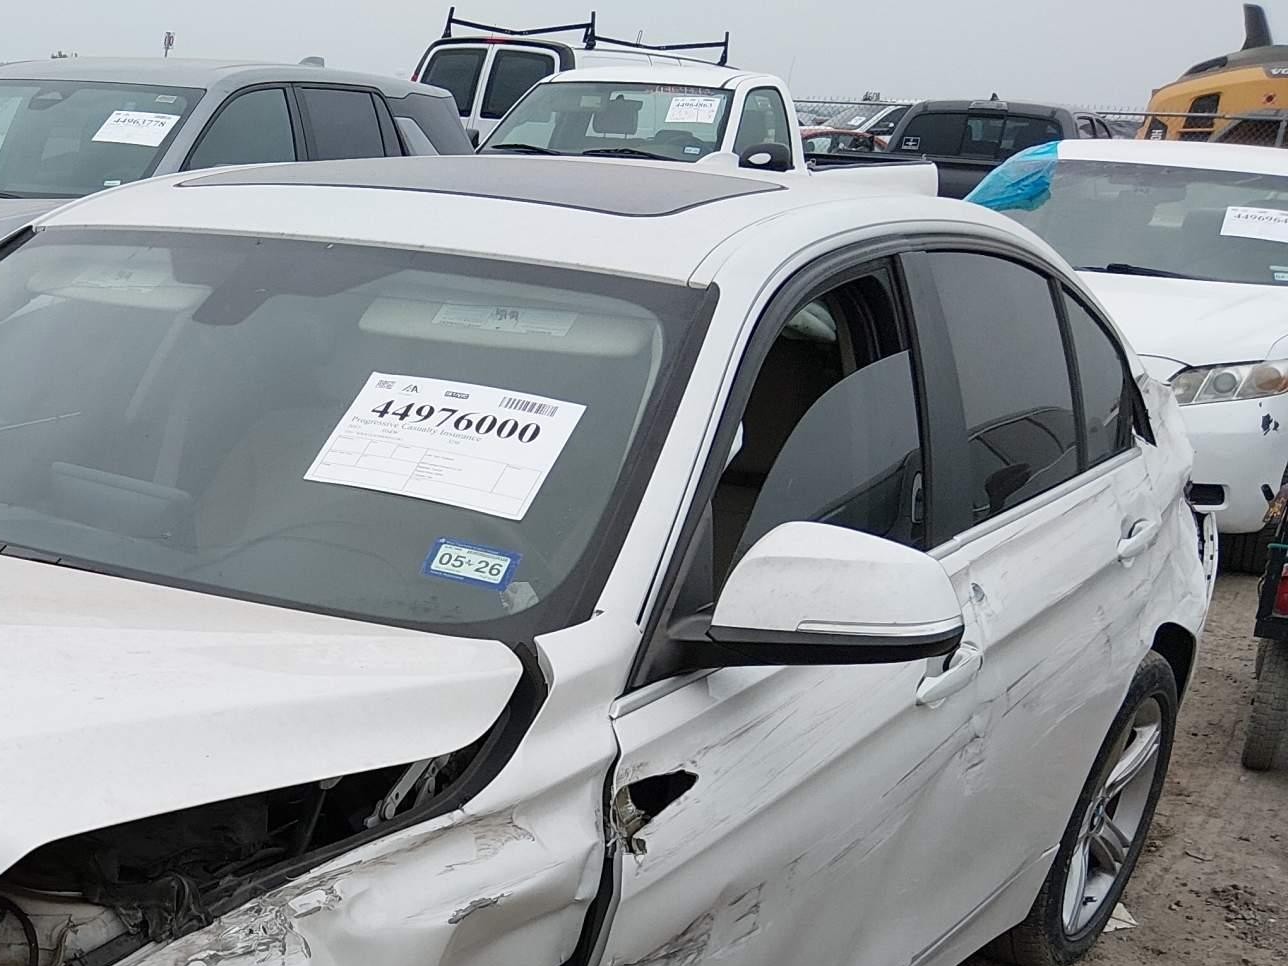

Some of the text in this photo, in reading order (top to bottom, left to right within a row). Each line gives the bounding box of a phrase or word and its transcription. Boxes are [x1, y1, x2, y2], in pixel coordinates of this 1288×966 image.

[351, 415, 399, 428] Progressive
[400, 422, 439, 435] Casualty
[439, 429, 483, 442] Insurance
[371, 400, 541, 443] 44976000
[474, 560, 503, 577] 26
